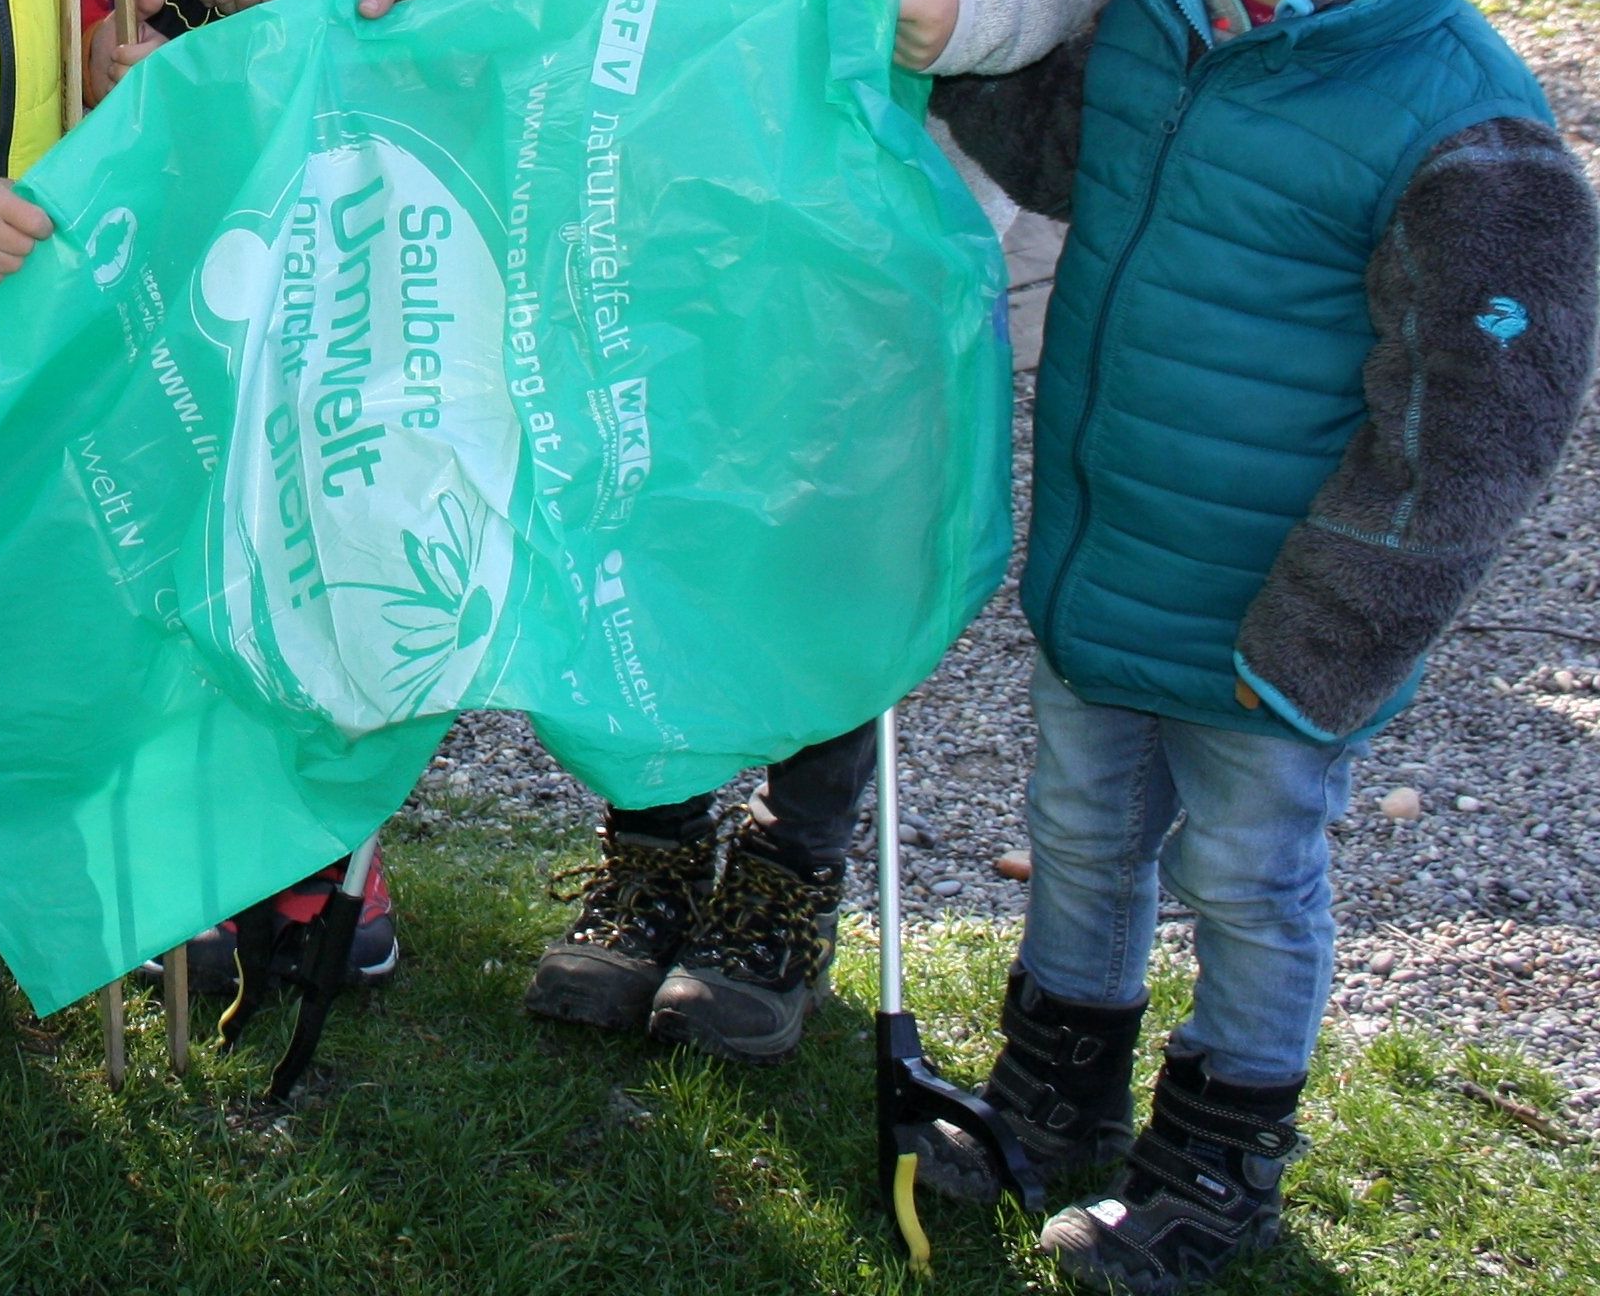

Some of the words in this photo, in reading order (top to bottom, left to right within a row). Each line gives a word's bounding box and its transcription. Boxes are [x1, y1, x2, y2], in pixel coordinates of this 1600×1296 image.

[600, 58, 632, 86] V
[313, 176, 386, 498] Umwelt
[399, 205, 455, 430] Saubere
[587, 110, 633, 360] naturvielfalt
